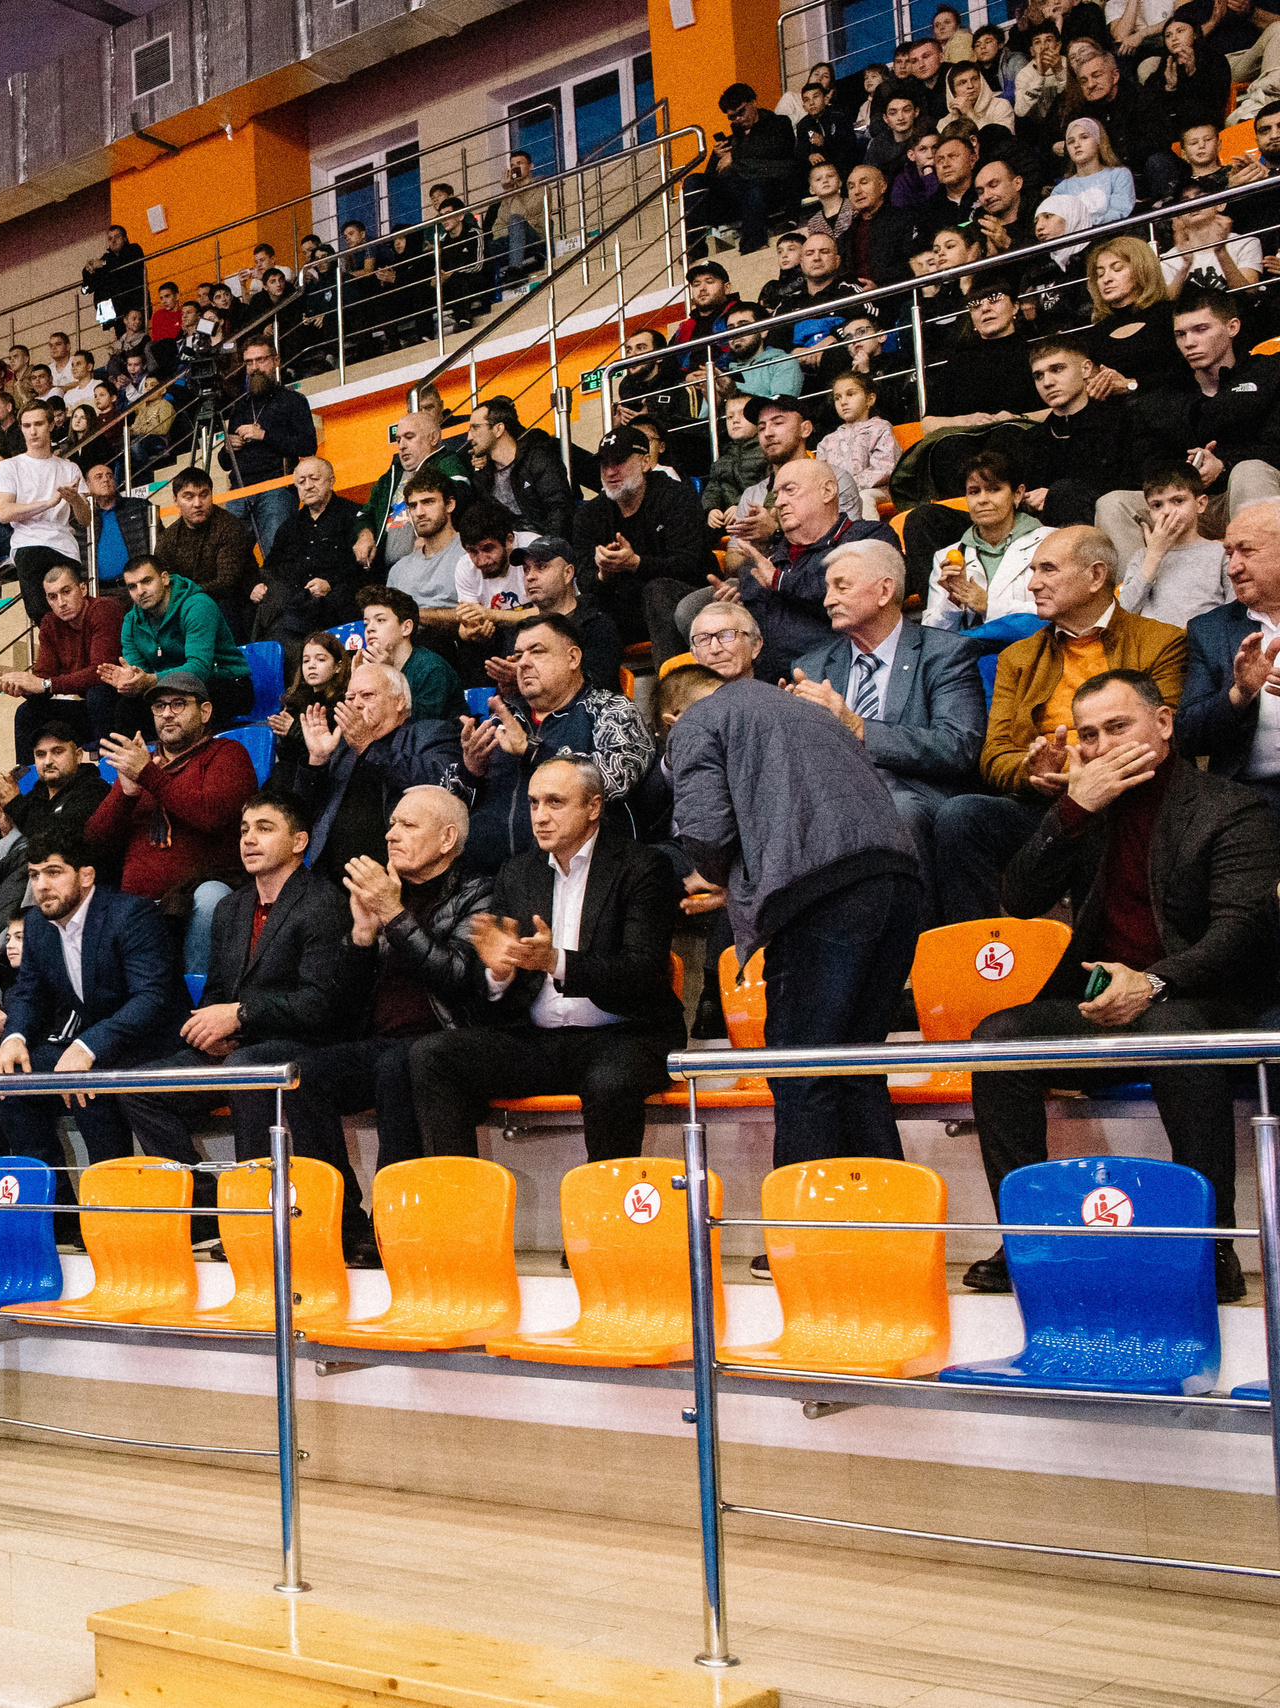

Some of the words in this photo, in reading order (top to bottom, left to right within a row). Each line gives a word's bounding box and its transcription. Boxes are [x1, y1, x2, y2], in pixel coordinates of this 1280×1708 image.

[990, 930, 1000, 938] 10
[641, 1170, 647, 1179] 9
[850, 1172, 861, 1181] 10
